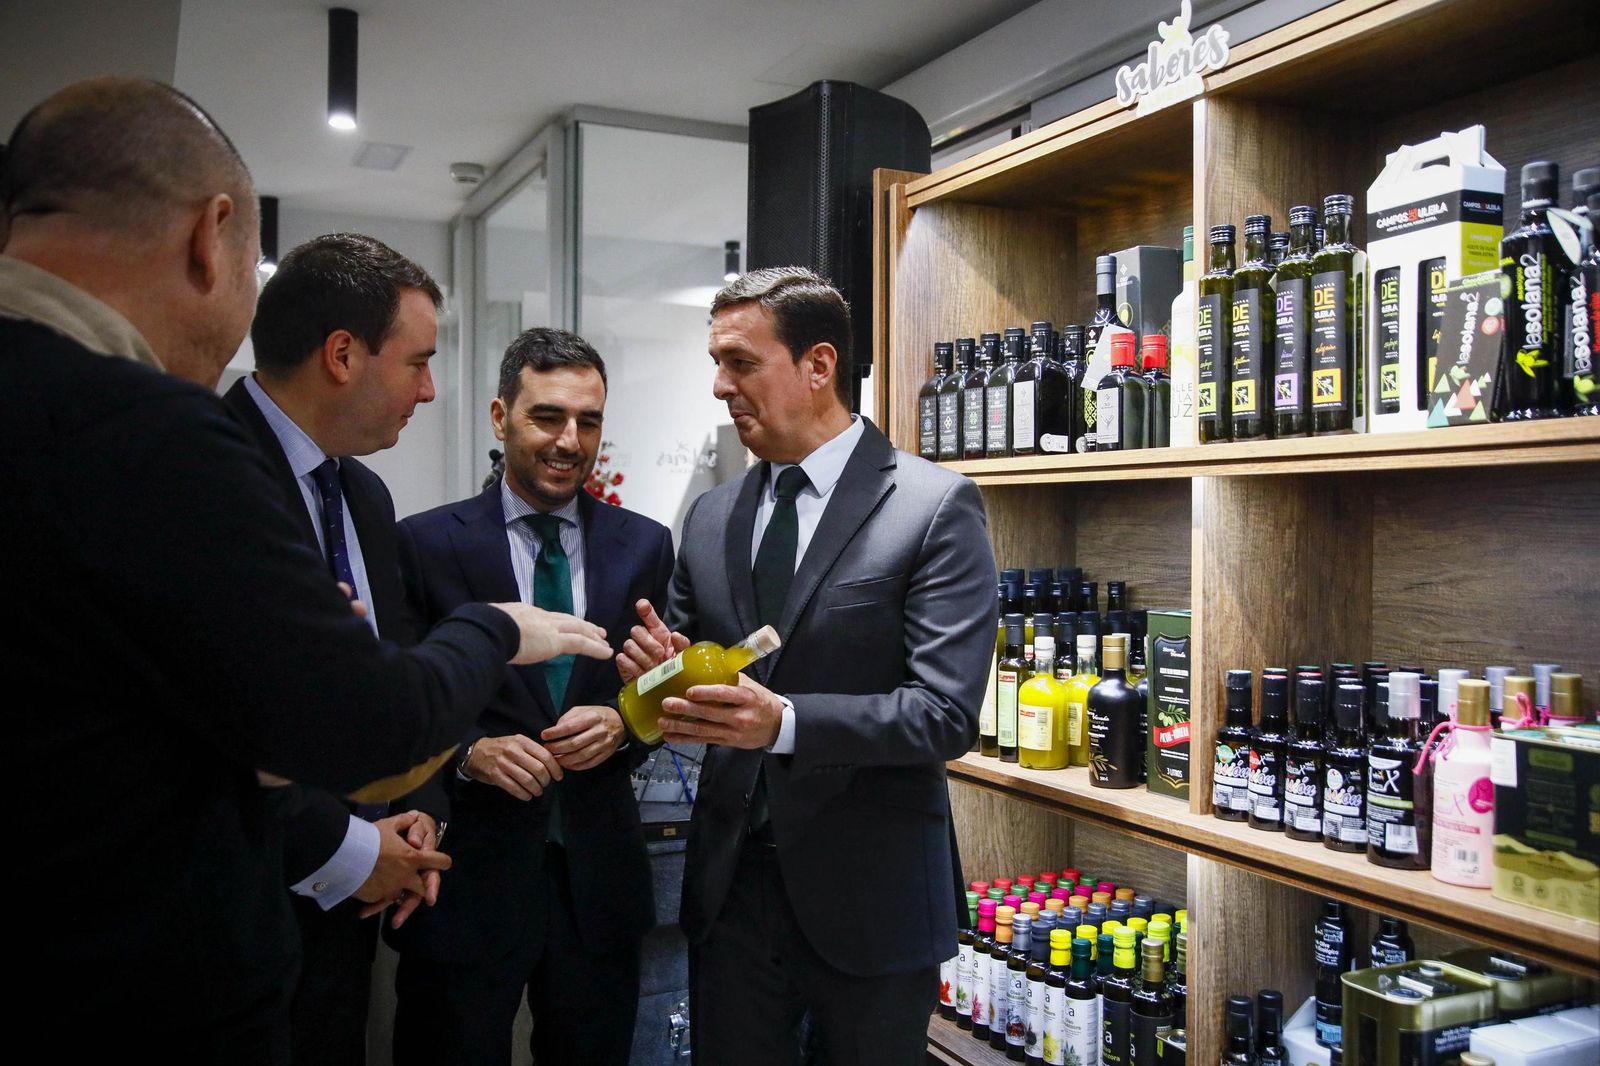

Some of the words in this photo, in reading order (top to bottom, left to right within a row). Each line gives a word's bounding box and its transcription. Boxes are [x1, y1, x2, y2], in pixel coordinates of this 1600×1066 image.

[1376, 212, 1409, 229] CAMPOS
[1418, 201, 1448, 218] ULEILA
[1430, 271, 1446, 289] D
[1314, 288, 1335, 306] DE
[1381, 281, 1398, 300] DE
[1277, 295, 1294, 313] DE
[1519, 252, 1543, 349] lasolana2
[1232, 303, 1250, 321] DE
[1172, 403, 1193, 418] UZ
